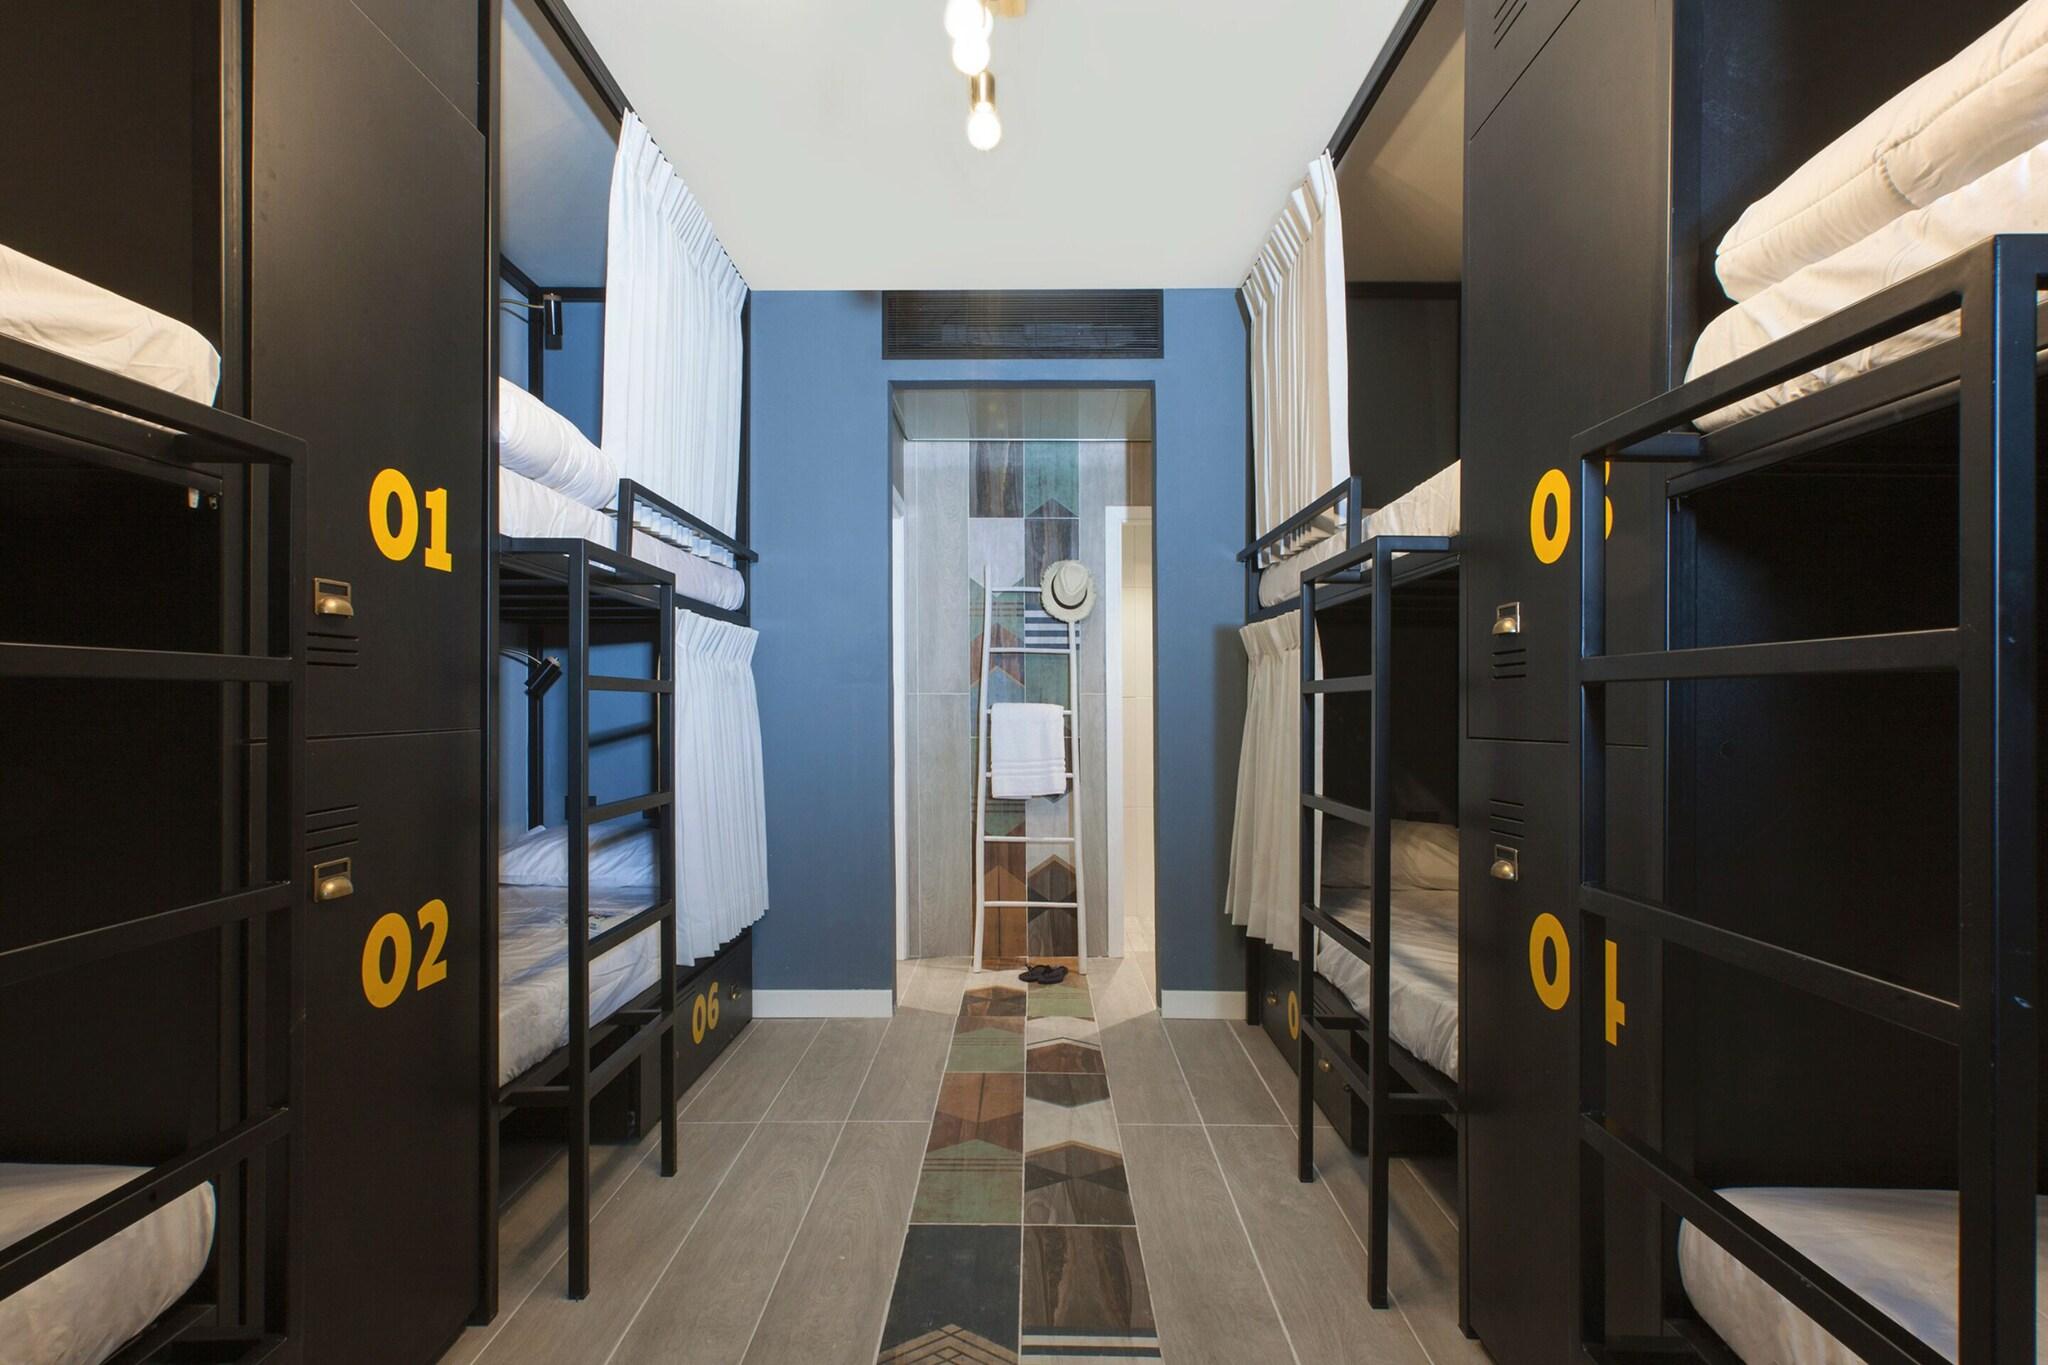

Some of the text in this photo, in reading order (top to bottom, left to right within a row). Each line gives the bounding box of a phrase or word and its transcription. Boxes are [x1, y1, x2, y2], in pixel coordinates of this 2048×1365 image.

[369, 468, 452, 572] 01
[1530, 459, 1613, 564] 0
[361, 898, 449, 1008] 02
[692, 981, 719, 1045] 06
